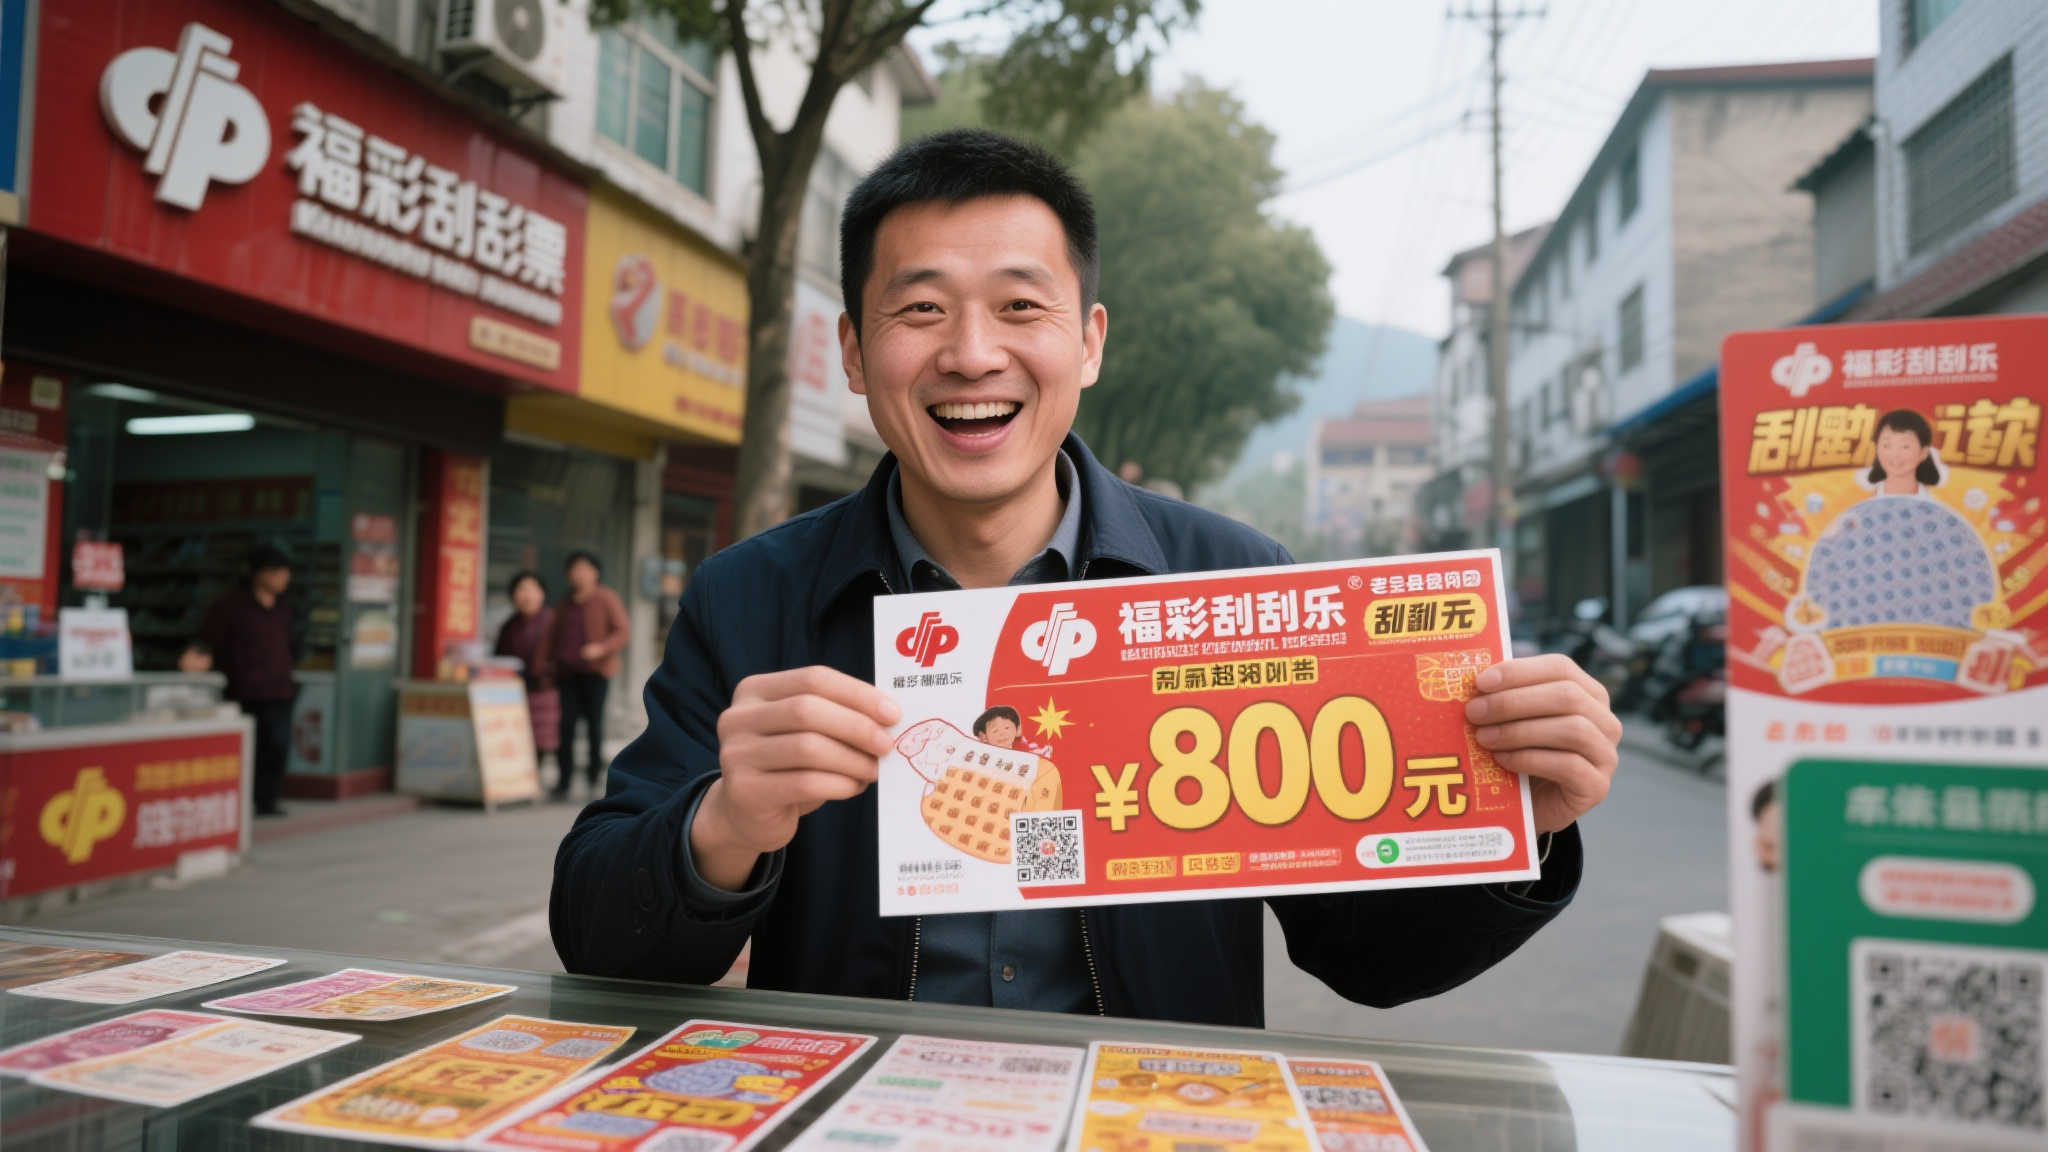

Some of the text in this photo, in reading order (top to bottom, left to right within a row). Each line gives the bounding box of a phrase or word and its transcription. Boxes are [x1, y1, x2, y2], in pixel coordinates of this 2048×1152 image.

[1118, 585, 1347, 645] 福彩刮刮乐
